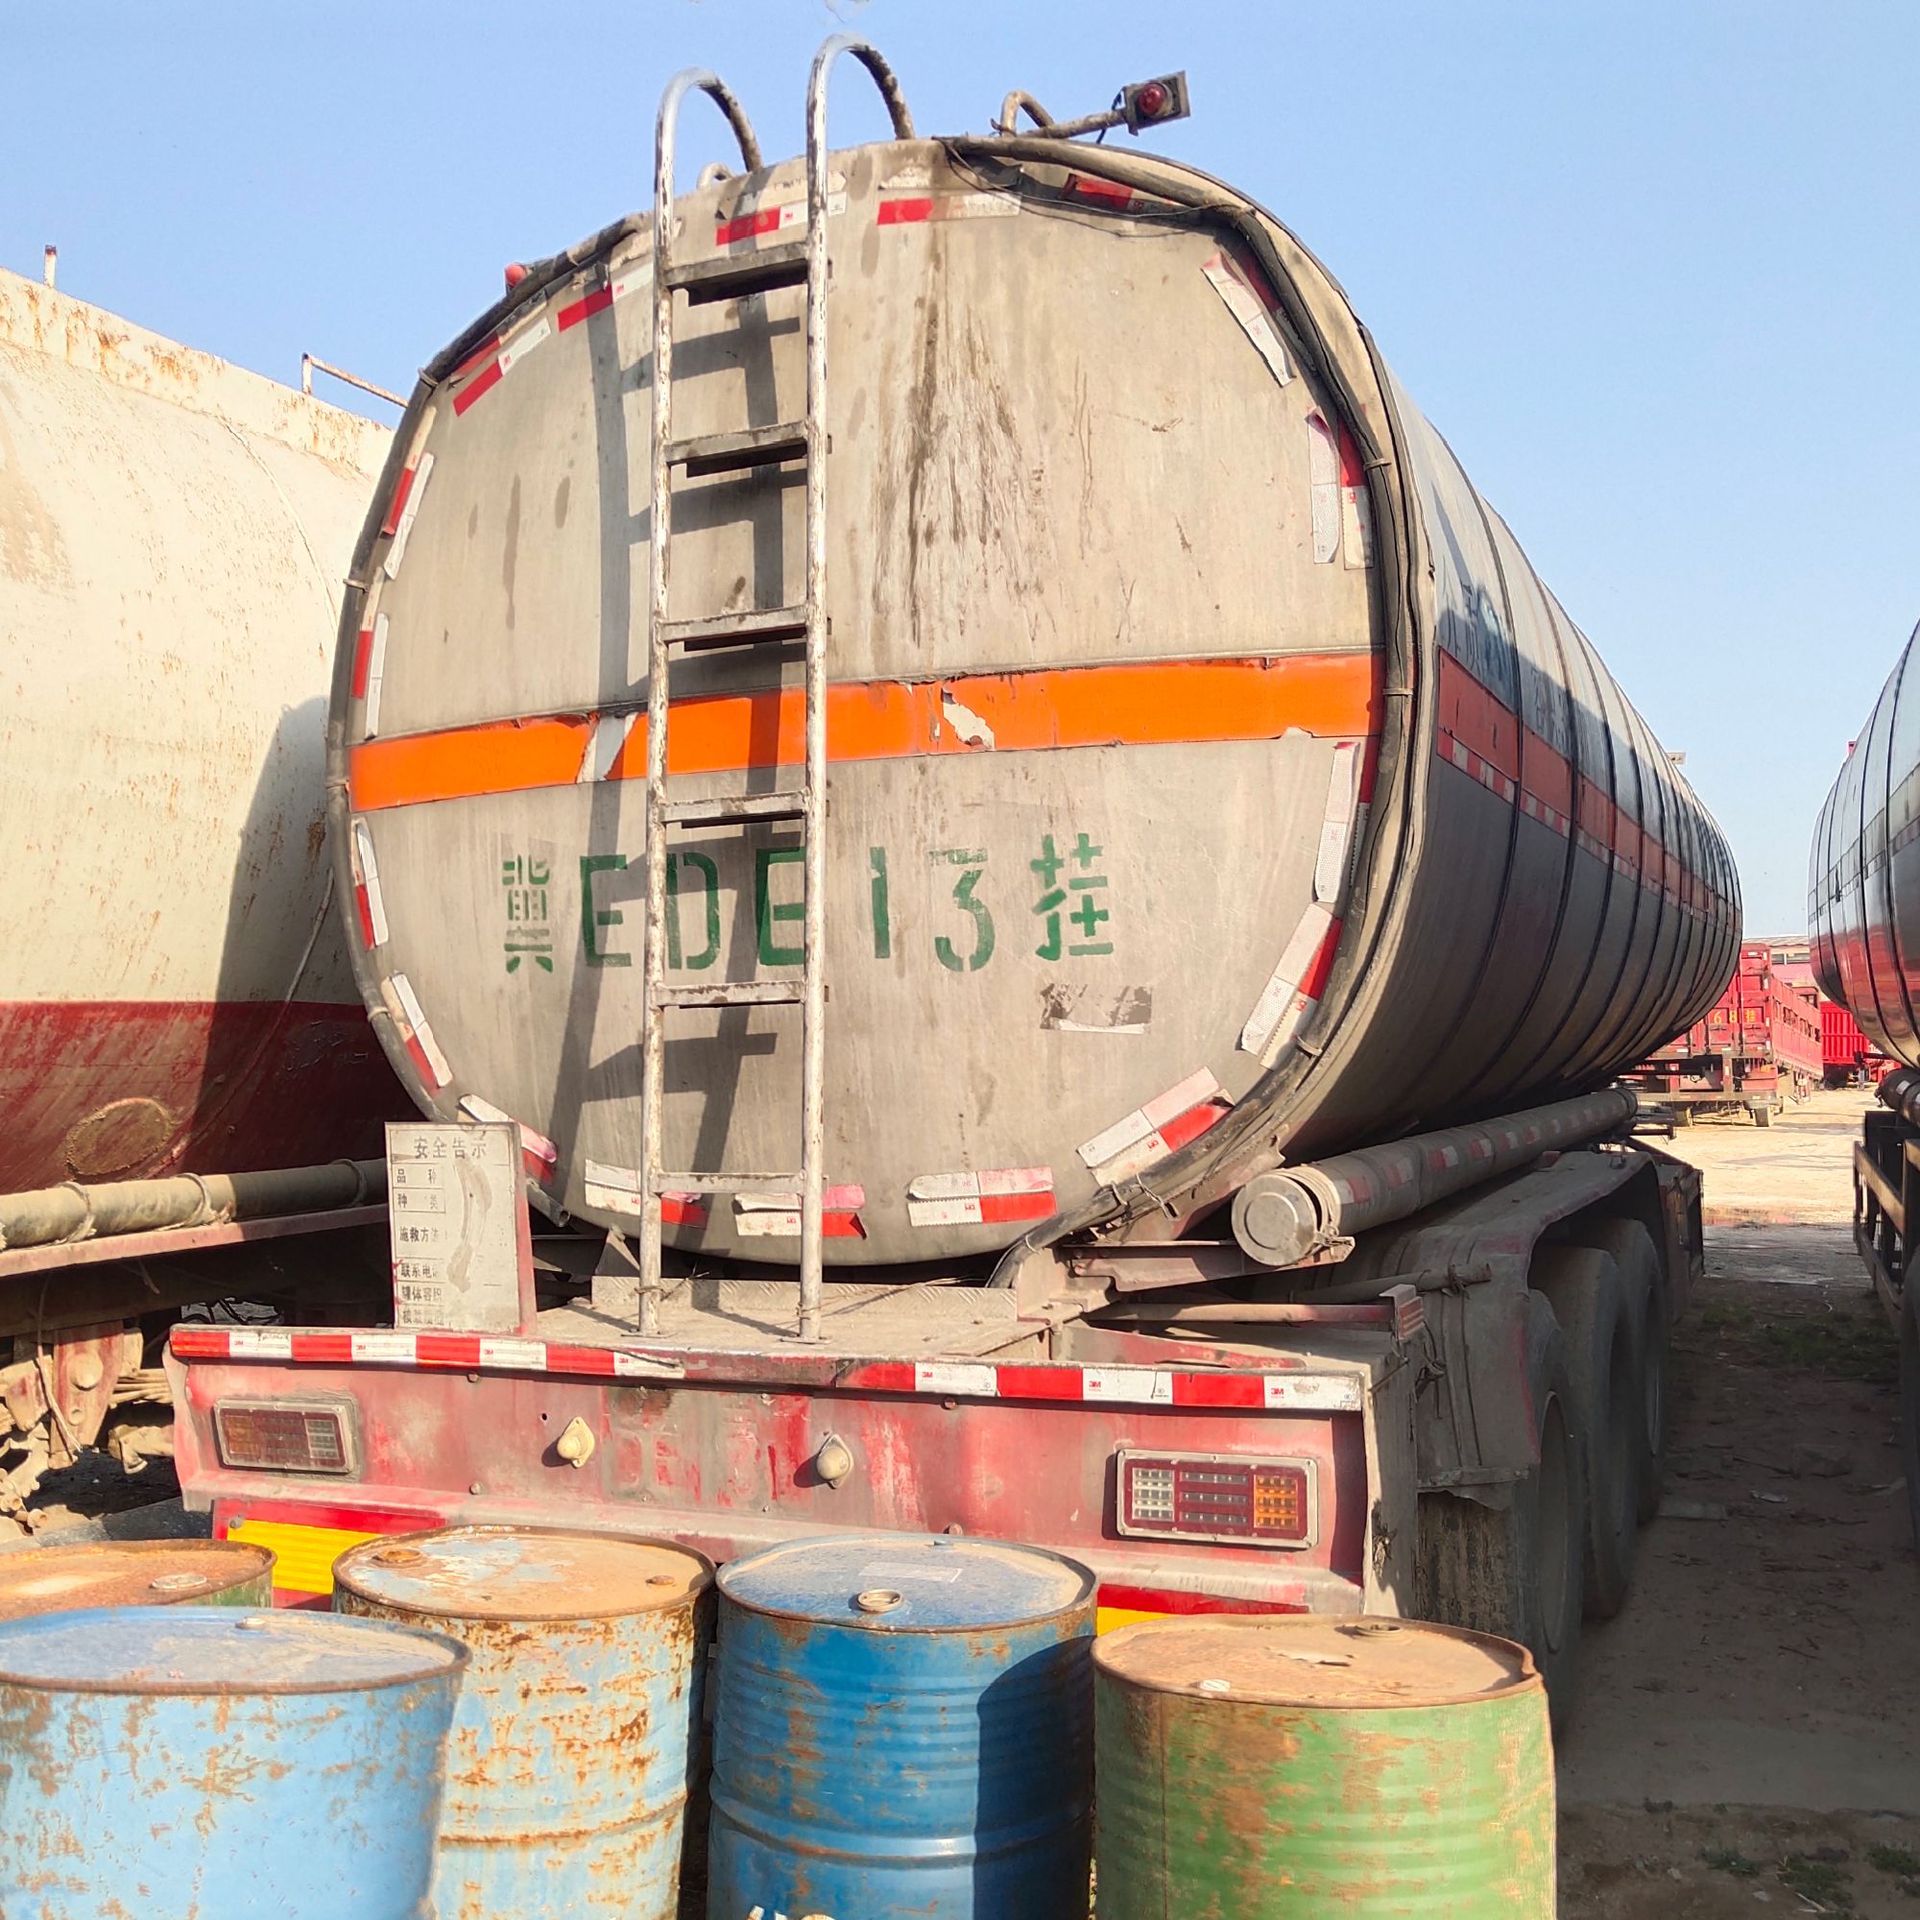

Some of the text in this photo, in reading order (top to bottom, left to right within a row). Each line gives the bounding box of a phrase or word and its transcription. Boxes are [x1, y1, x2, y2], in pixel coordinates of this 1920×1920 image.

[413, 1135, 487, 1160] 安全告示
[400, 1262, 439, 1278] 联系电
